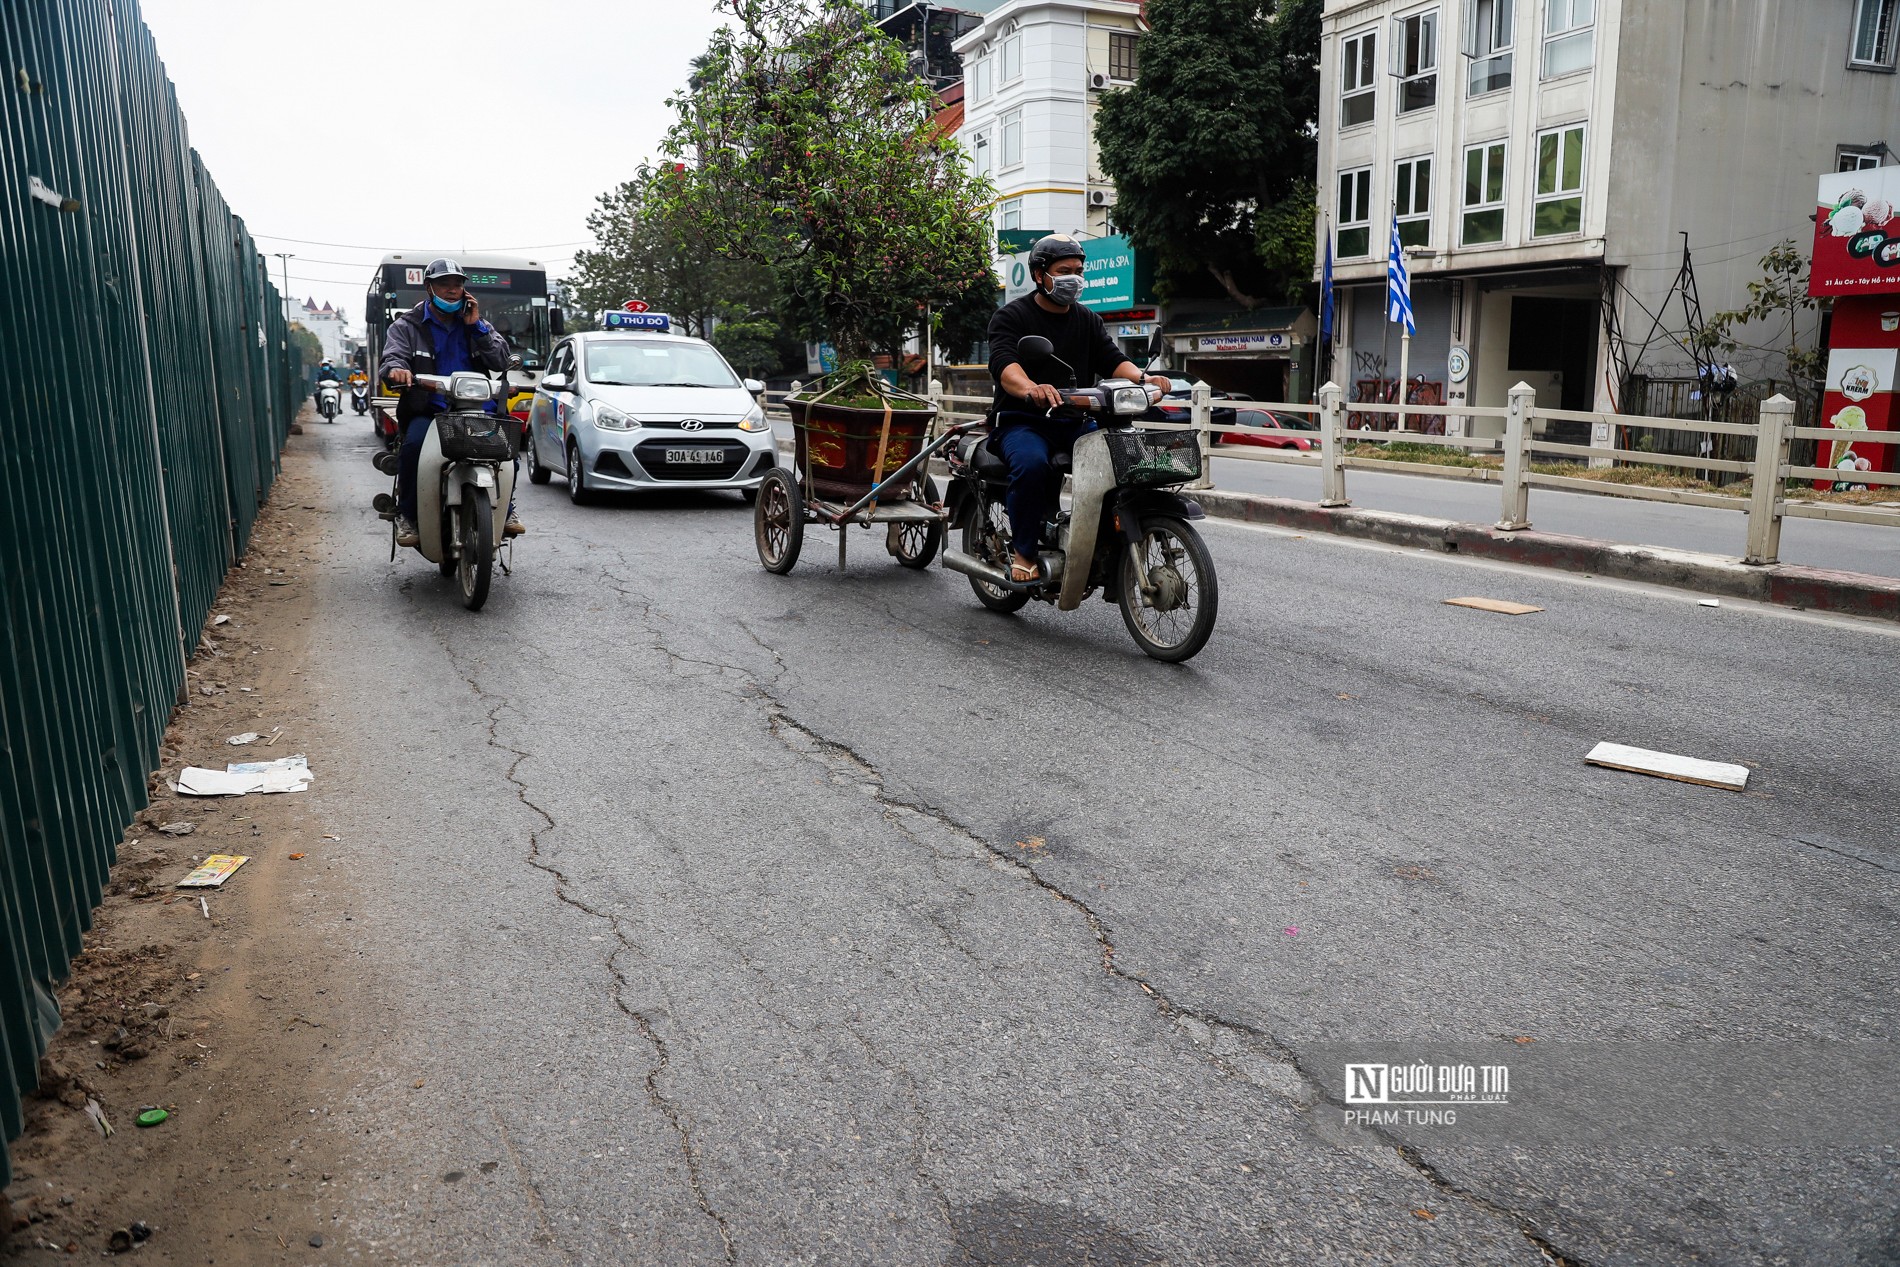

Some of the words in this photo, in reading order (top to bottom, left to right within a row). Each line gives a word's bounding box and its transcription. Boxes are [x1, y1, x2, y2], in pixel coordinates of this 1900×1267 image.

[1116, 255, 1129, 267] SPA
[408, 271, 421, 282] 41
[1106, 276, 1118, 285] CAO
[622, 316, 644, 325] THỦ
[647, 317, 663, 325] ĐÔ
[1217, 337, 1225, 345] TY
[1225, 336, 1240, 345] TNHH
[1240, 336, 1251, 344] MAI
[1252, 335, 1265, 343] NAM
[1845, 384, 1869, 395] KREAM
